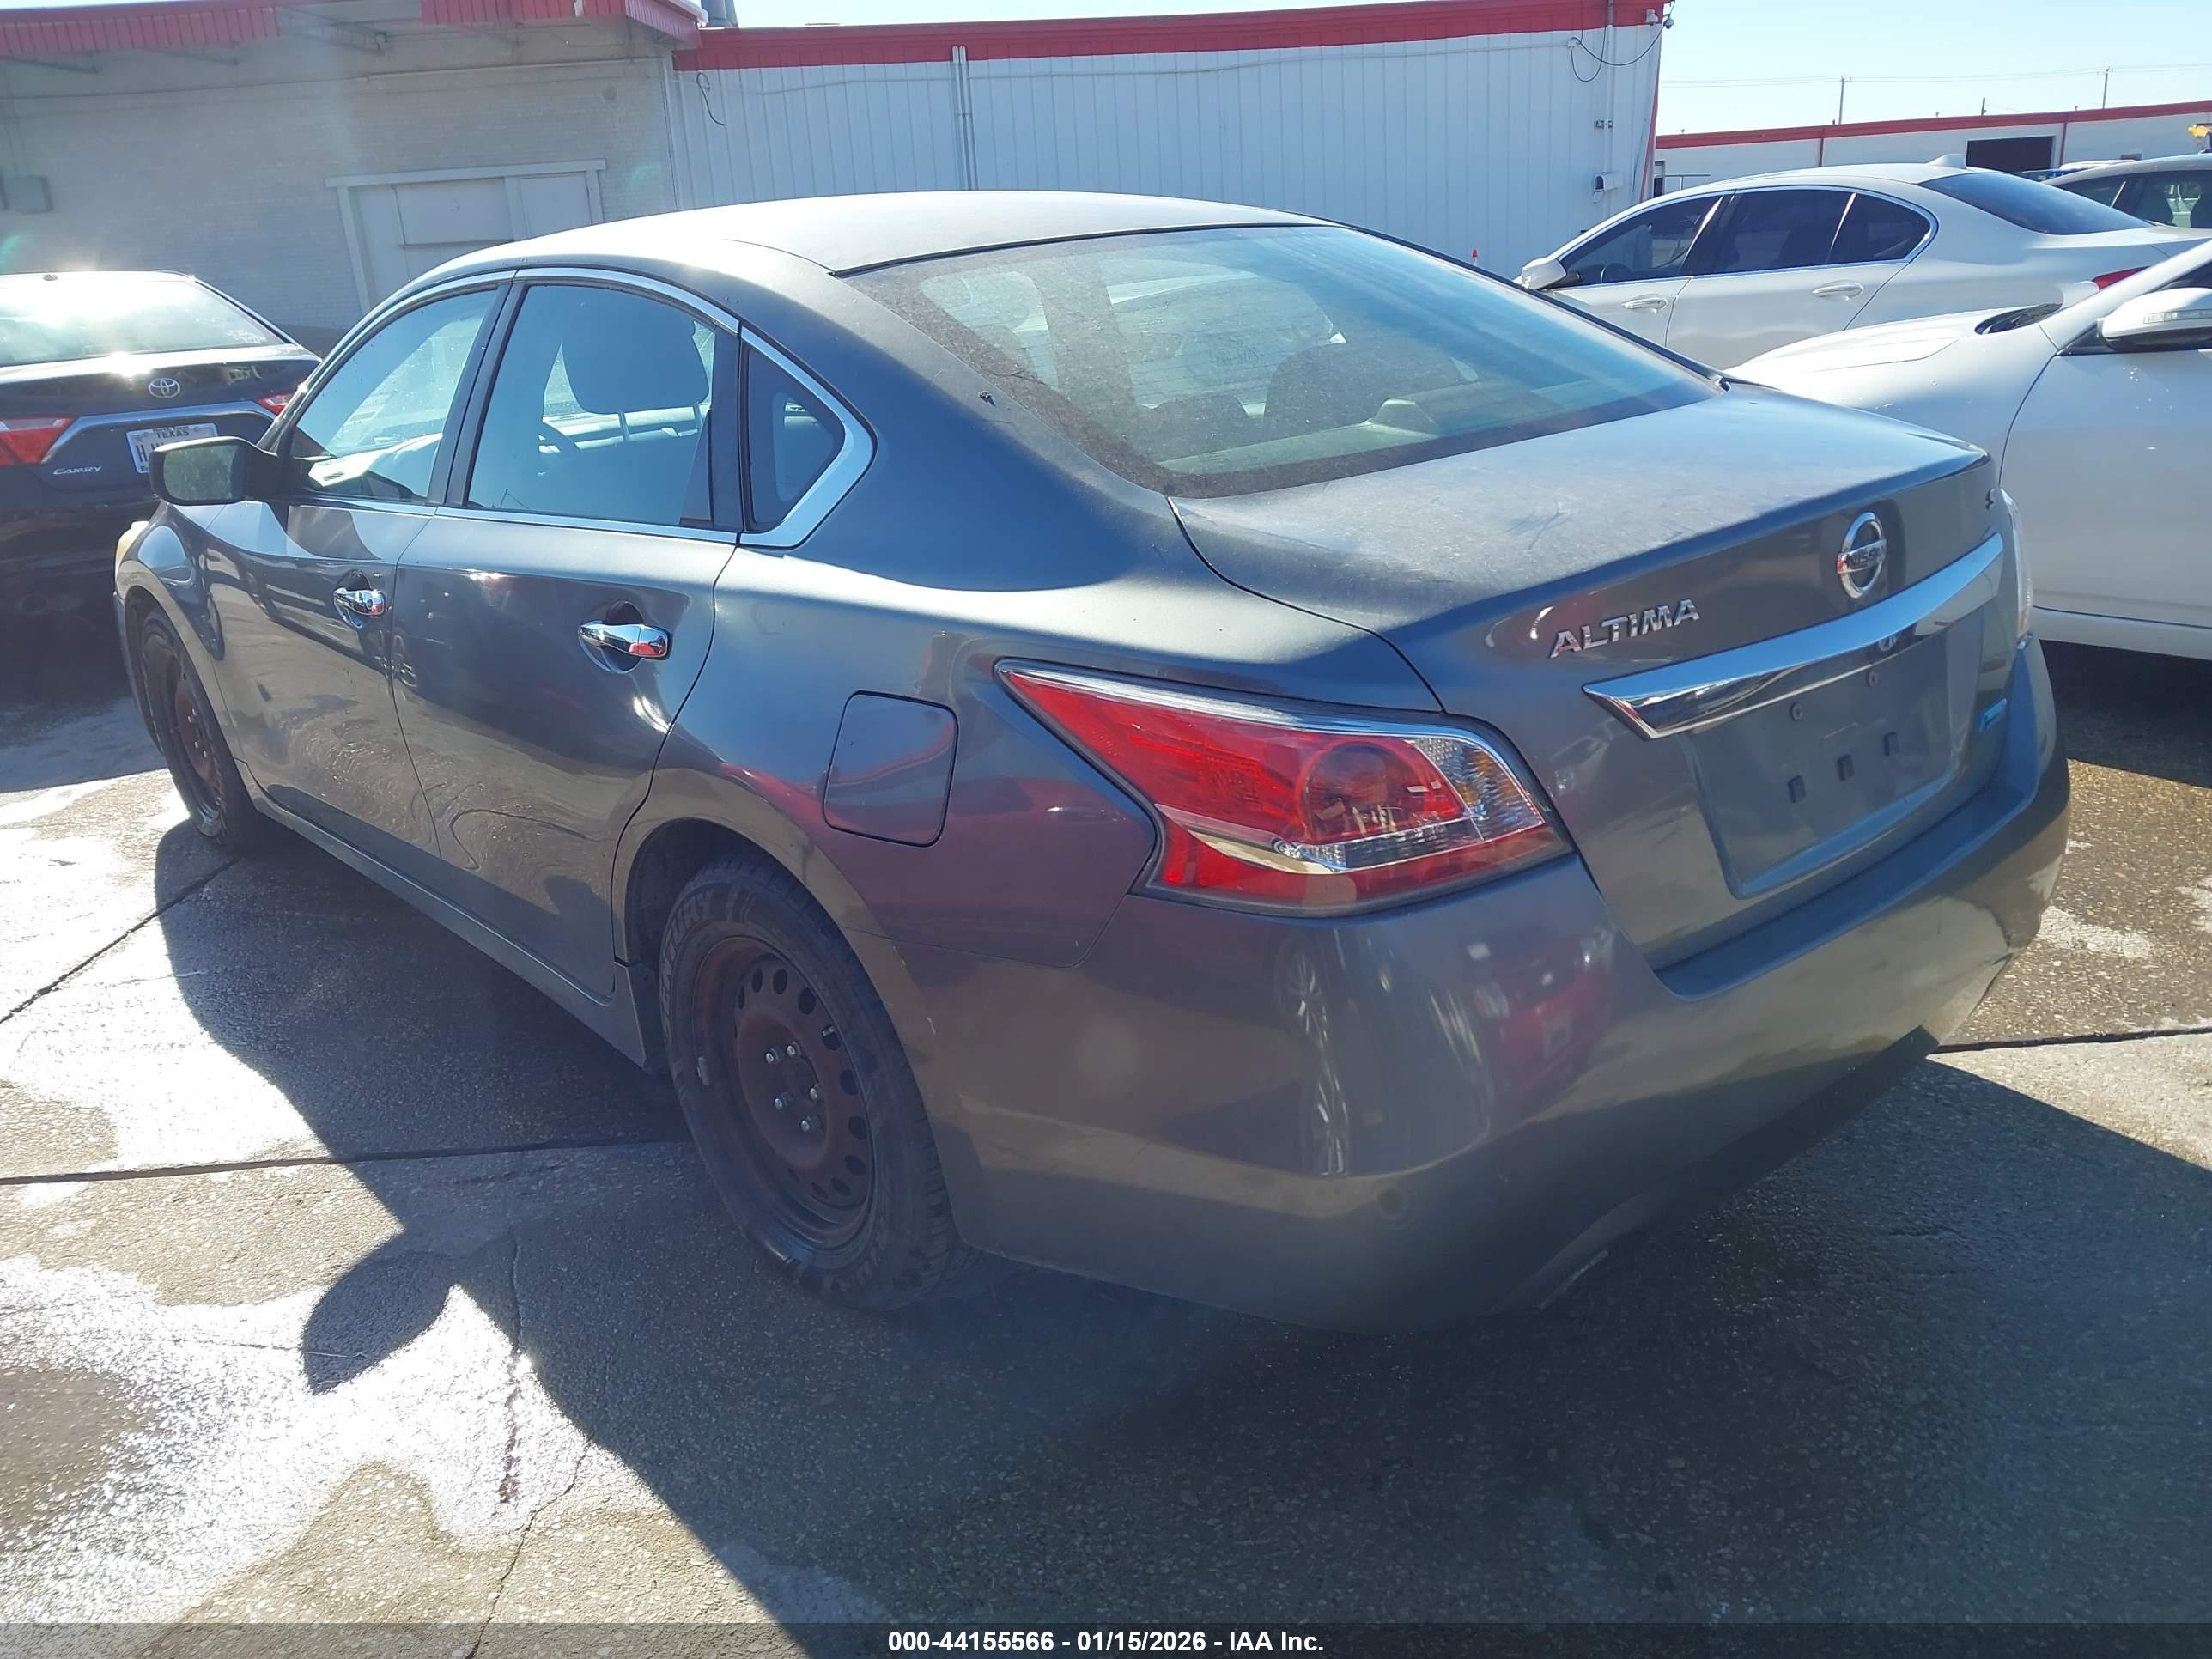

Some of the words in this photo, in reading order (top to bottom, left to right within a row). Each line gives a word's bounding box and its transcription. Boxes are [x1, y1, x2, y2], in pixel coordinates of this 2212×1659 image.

[156, 429, 189, 439] TEXAS
[53, 465, 102, 475] CAMRY
[1549, 598, 1701, 659] ALTIMA
